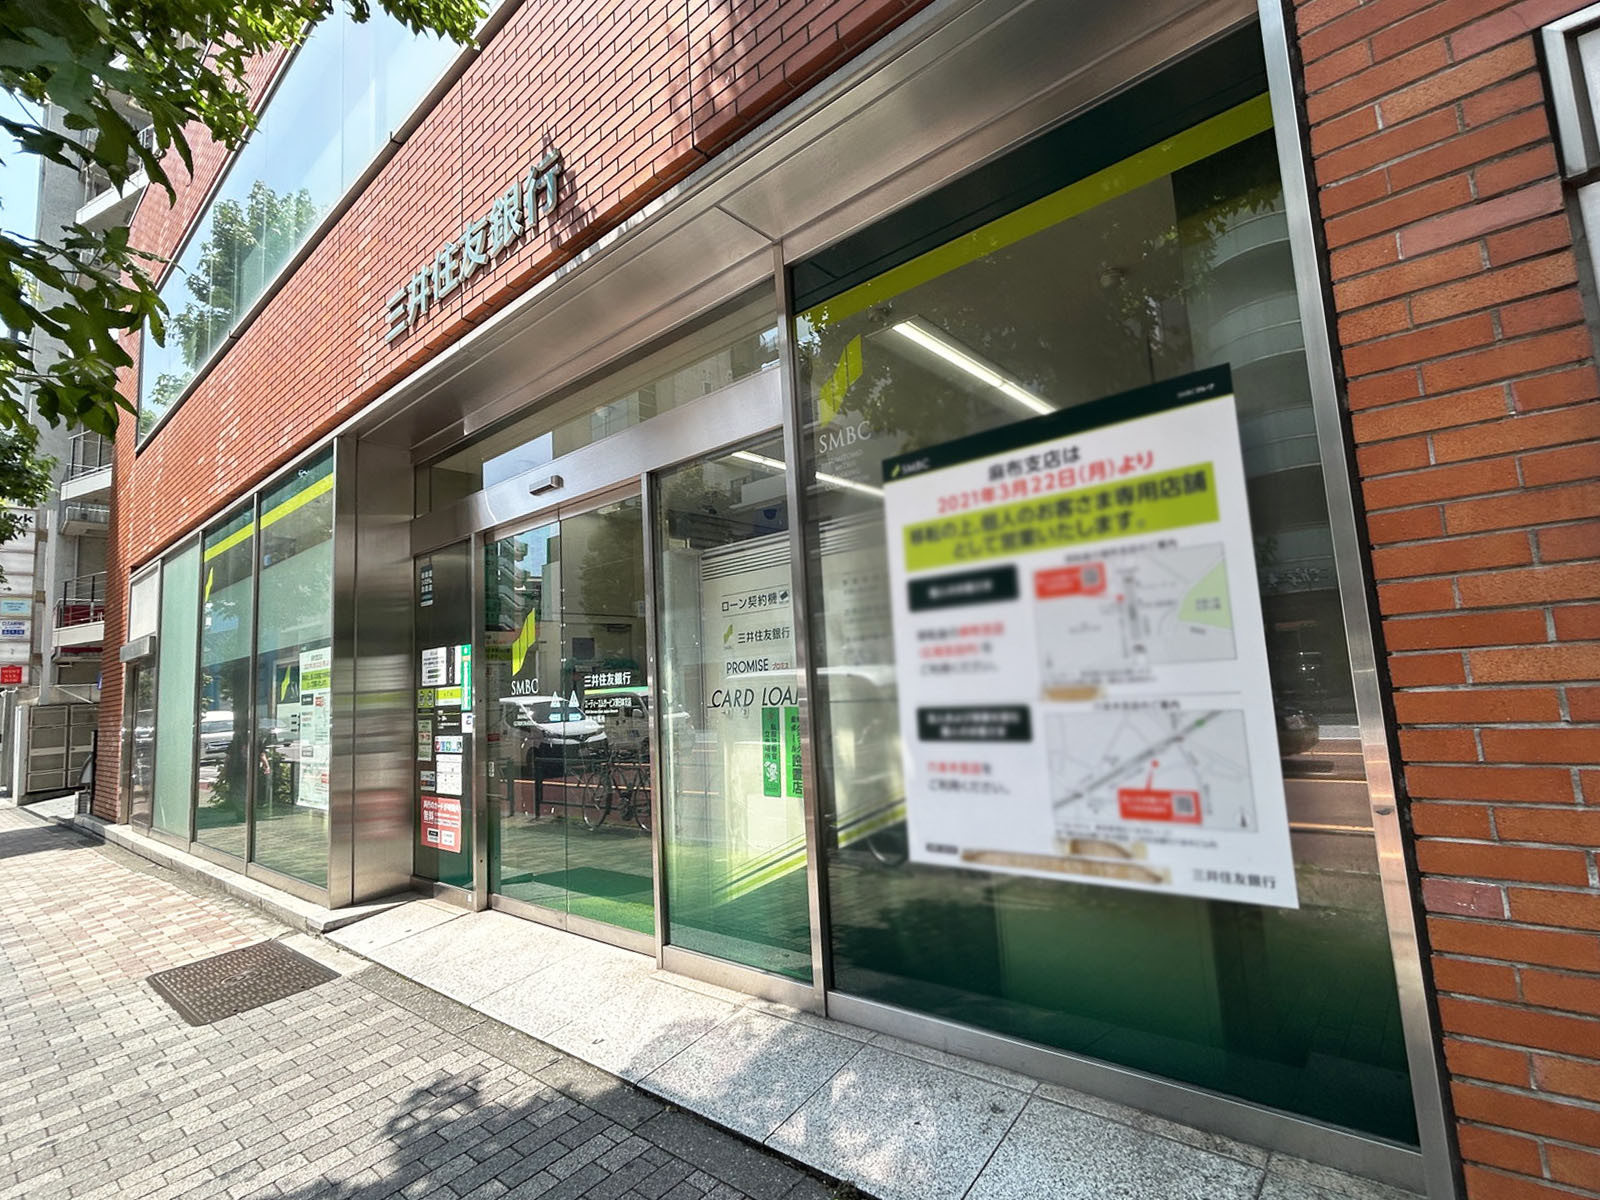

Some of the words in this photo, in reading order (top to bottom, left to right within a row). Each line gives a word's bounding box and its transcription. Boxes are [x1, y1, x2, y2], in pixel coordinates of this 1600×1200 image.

[384, 147, 563, 343] 三井住友銀行
[819, 421, 872, 454] SMBC
[901, 457, 931, 472] SMBC
[988, 446, 1081, 481] 麻布支店は
[953, 511, 1149, 559] として営業いたします。
[721, 591, 778, 612] ローン契約機
[737, 626, 790, 644] 三井住友銀行
[726, 658, 769, 675] PROMISE
[510, 678, 540, 696] SMBC
[583, 671, 632, 688] 三井住友銀行
[707, 688, 755, 709] CARD
[1192, 868, 1278, 890] 三井住友銀行
